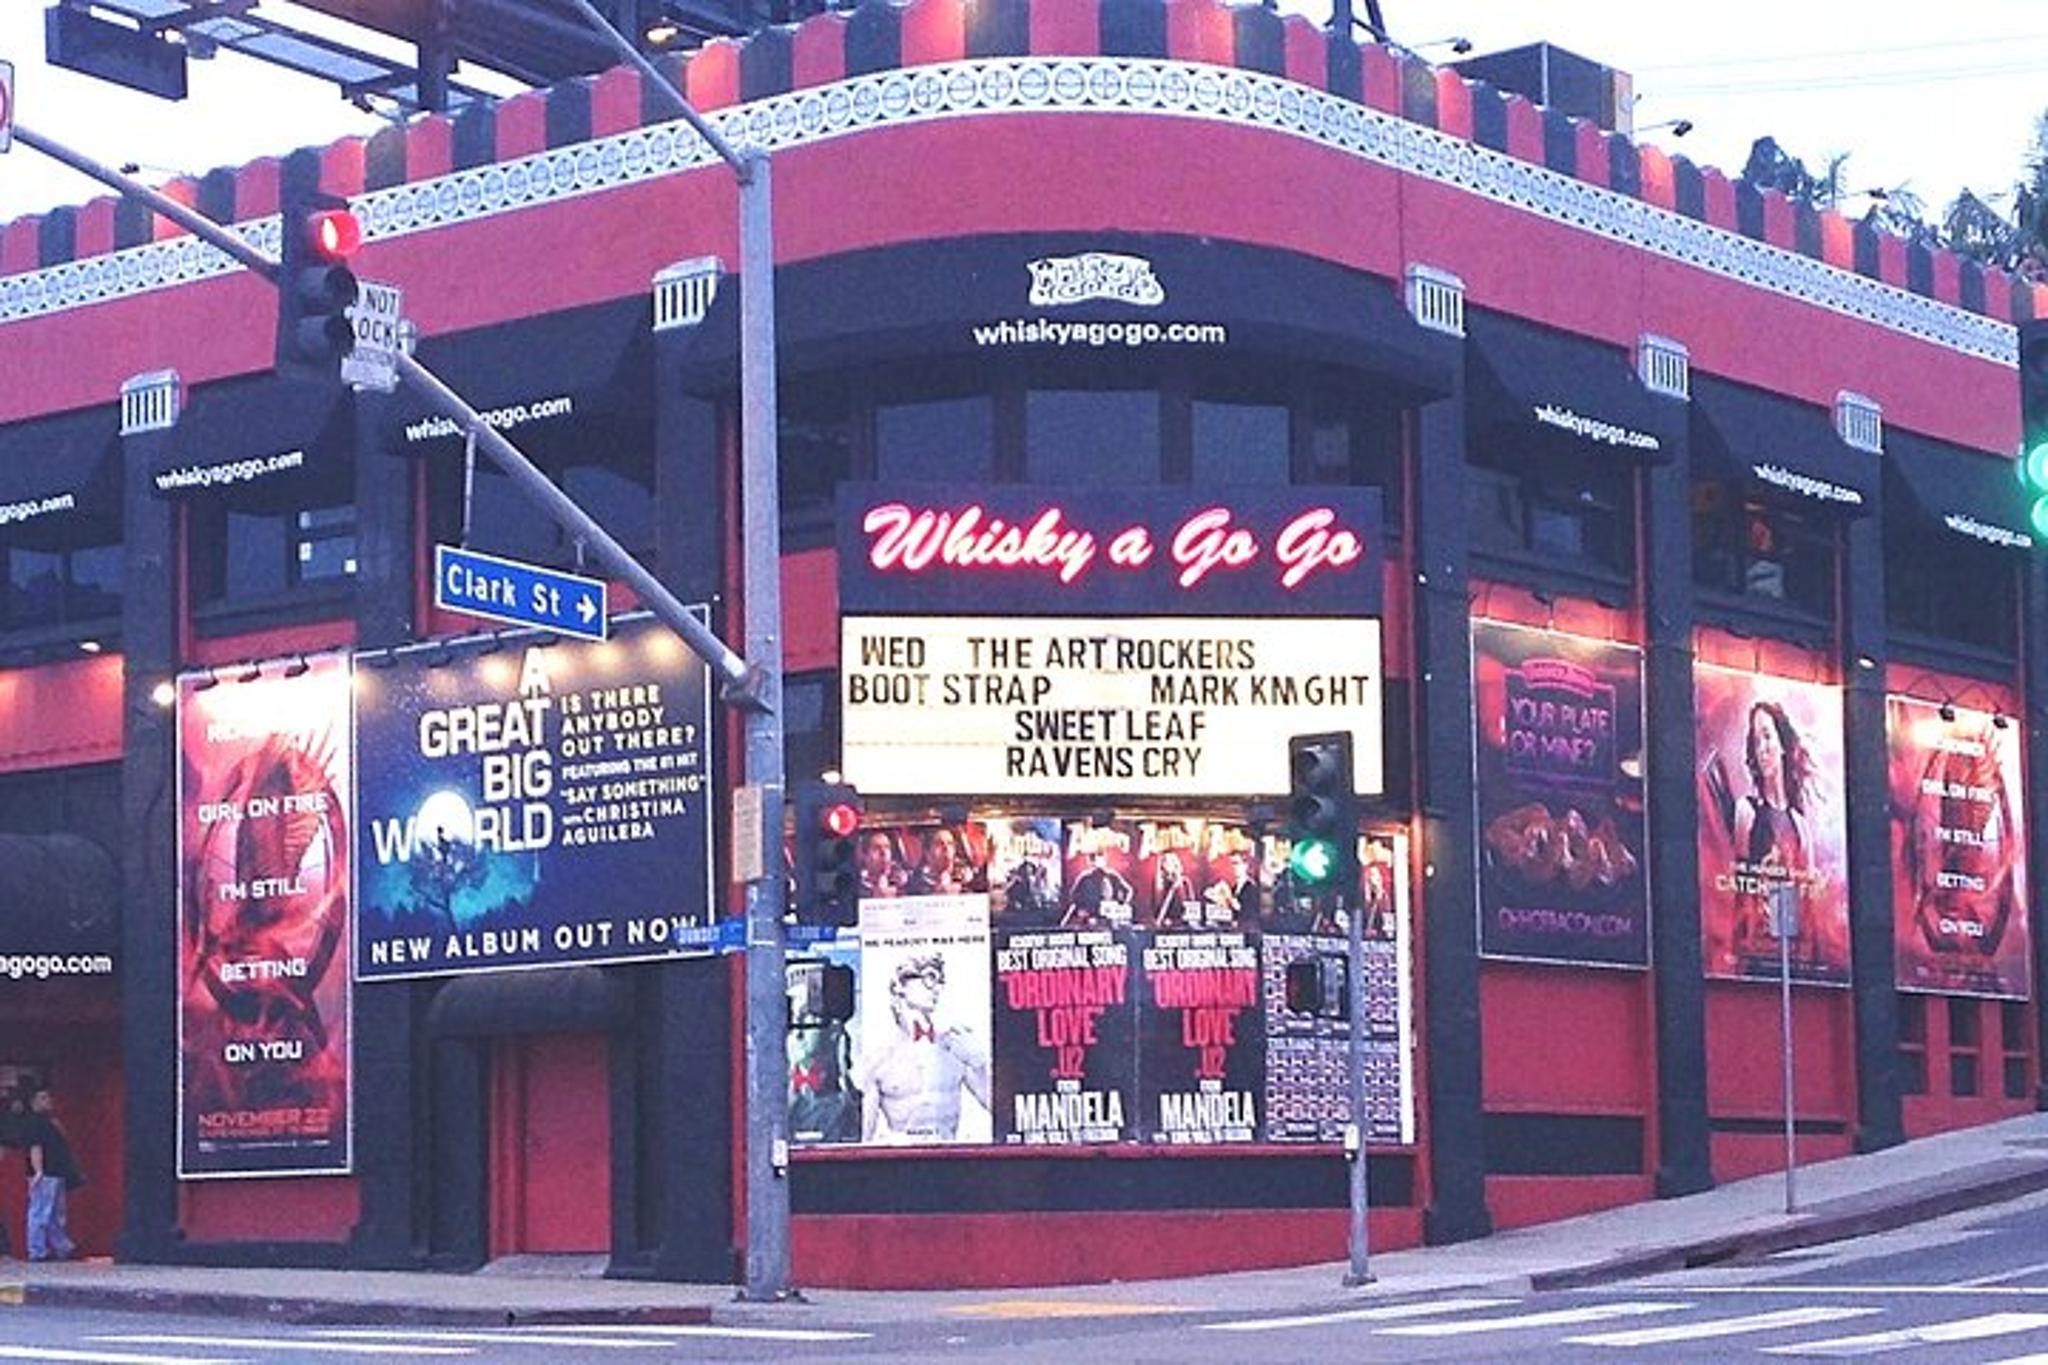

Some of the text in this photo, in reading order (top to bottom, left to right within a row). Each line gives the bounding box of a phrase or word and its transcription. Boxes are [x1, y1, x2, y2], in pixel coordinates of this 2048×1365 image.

[358, 317, 394, 348] OCK
[972, 318, 1226, 345] whiskyagogo.com
[1534, 404, 1660, 450] whiskyagogo.com
[155, 450, 304, 489] whiskyagogo.com
[1752, 462, 1862, 505] whiskyagogo.com
[862, 504, 1363, 590] Whisky a Go Go
[446, 563, 561, 616] Clark St
[861, 636, 1256, 670] WED THE ART ROCKERS
[519, 647, 550, 695] A
[560, 684, 661, 714] IS THERE
[848, 673, 931, 705] BOOT
[943, 673, 1052, 706] STRAP
[1150, 674, 1239, 706] MARK
[419, 698, 551, 758] GREAT
[561, 706, 664, 736] ANYBODY
[1014, 709, 1207, 742] SWEET LEAF
[561, 724, 696, 758] OUT THERE?
[483, 749, 552, 801] BIG
[1006, 746, 1203, 778] RAVENS CRY
[198, 792, 330, 823] GIRL ON FIRE
[583, 797, 686, 823] CHRISTINA
[561, 821, 655, 846] AGUILERA
[252, 876, 308, 898] STILL
[371, 937, 431, 964] NEW
[445, 929, 540, 958] ALBUM
[554, 922, 614, 950] OUT
[998, 948, 1029, 972] BEST
[1091, 942, 1128, 967] SONG
[220, 957, 307, 983] BETTING
[224, 1040, 304, 1063] ON YOU
[1014, 1090, 1125, 1132] MANDELA
[1159, 1090, 1257, 1132] MANDELA
